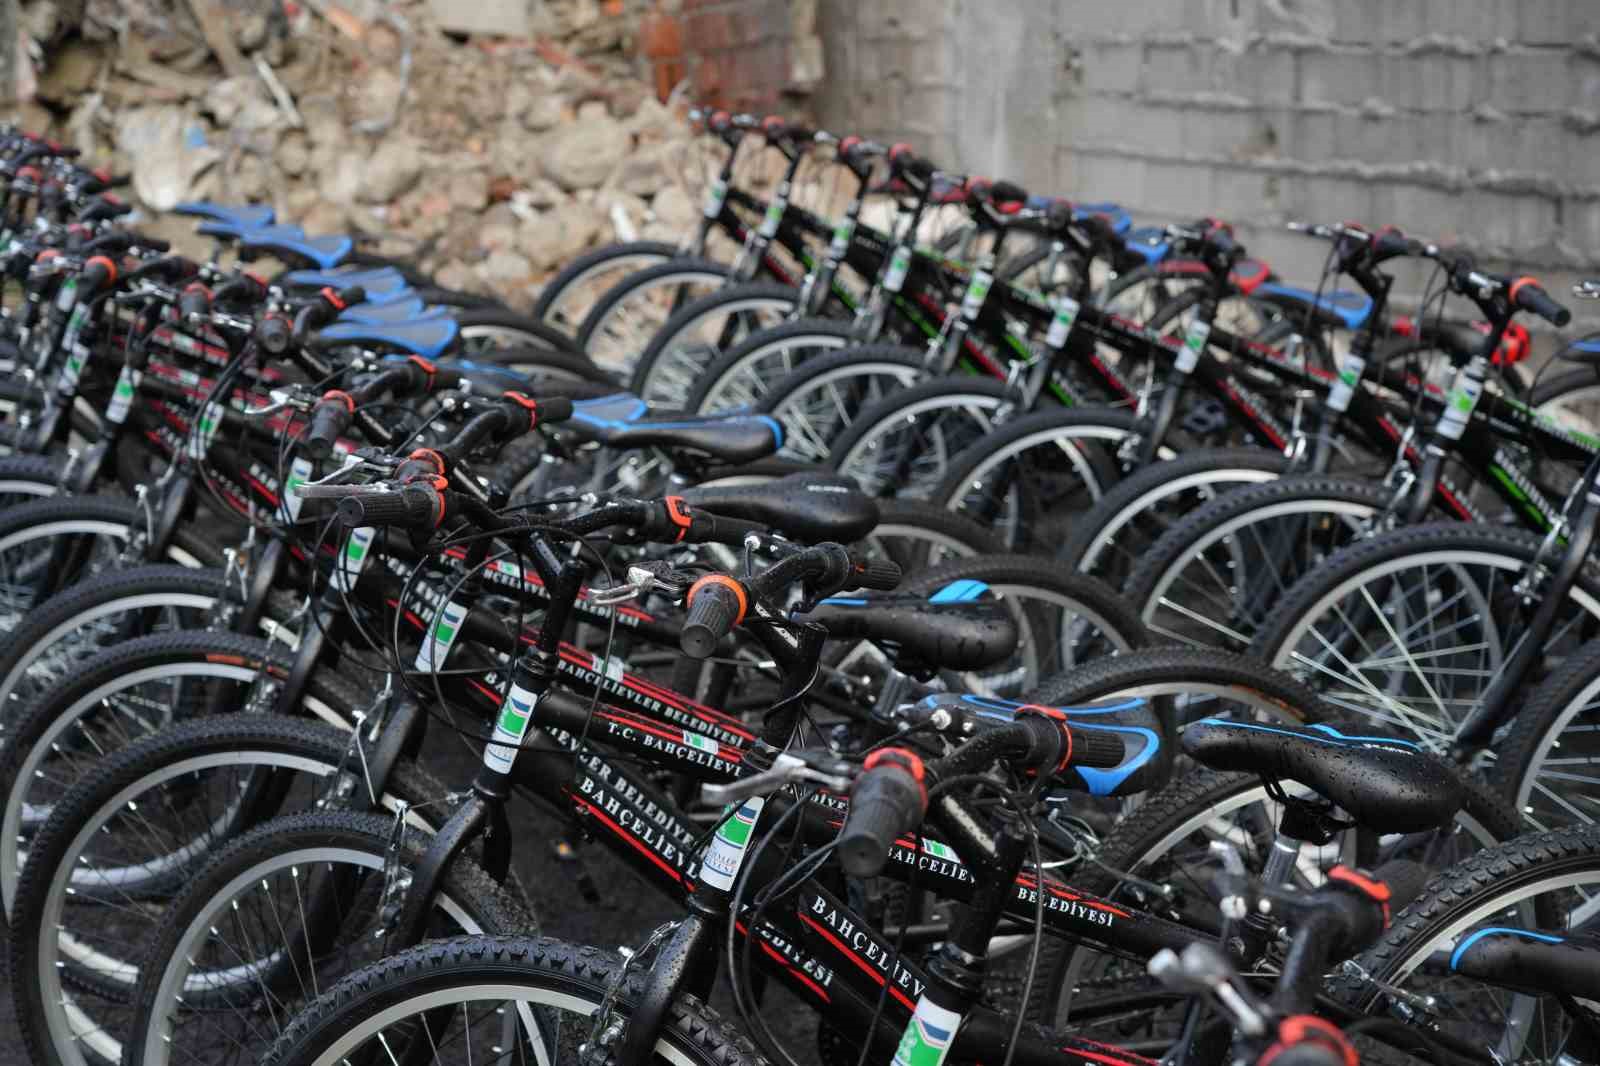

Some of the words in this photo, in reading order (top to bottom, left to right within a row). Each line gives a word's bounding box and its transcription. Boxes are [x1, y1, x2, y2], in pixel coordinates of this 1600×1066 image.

[607, 721, 638, 742] T.C.
[614, 776, 700, 850] BELEDİYE
[811, 895, 926, 997] BAHÇELİEV
